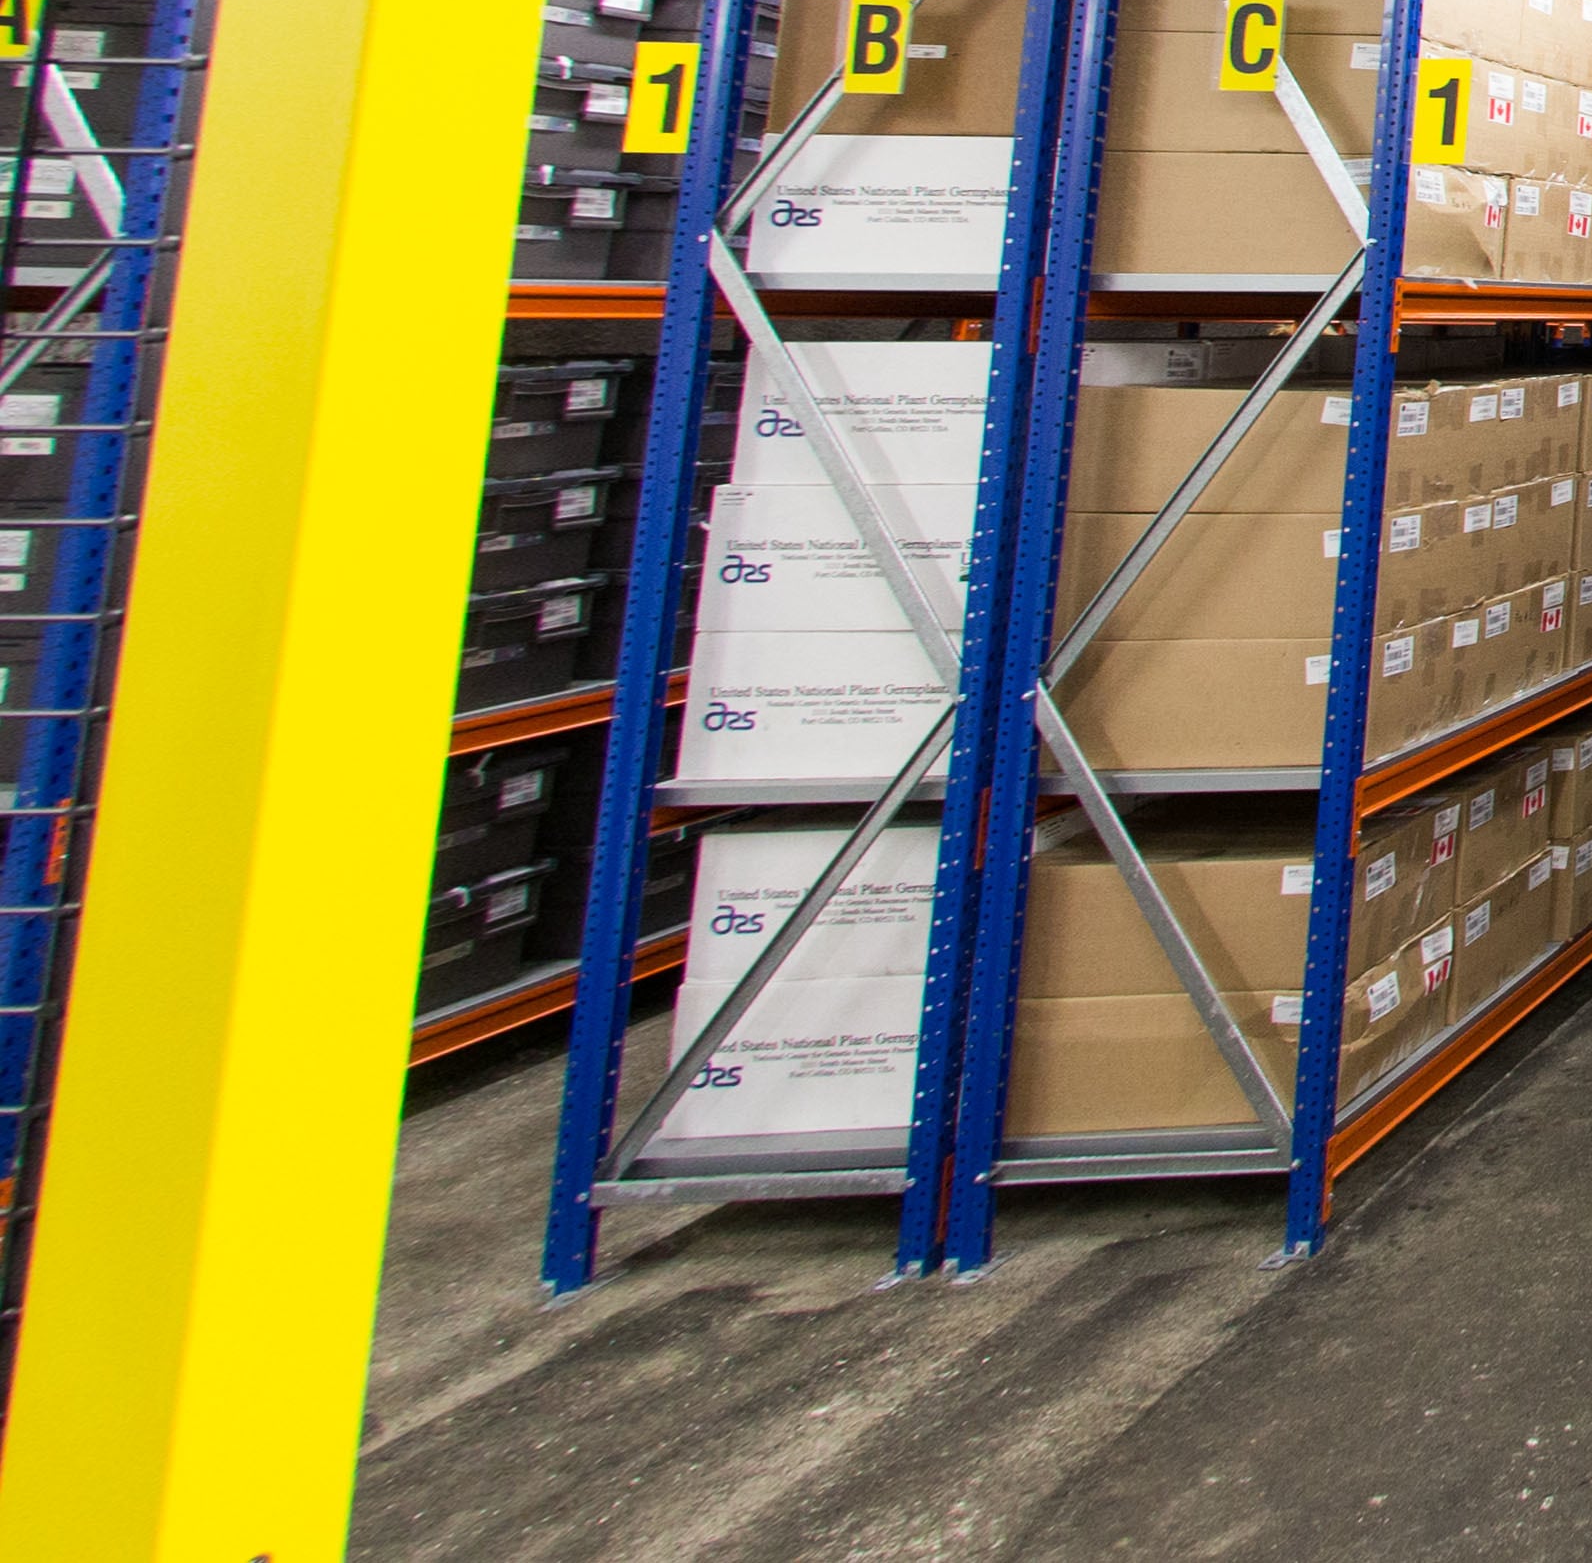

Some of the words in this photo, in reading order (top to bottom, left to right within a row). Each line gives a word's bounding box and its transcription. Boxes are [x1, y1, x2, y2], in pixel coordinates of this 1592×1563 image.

[853, 5, 898, 73] B
[1230, 4, 1274, 73] C
[649, 64, 685, 134] 1
[1429, 78, 1458, 145] 1
